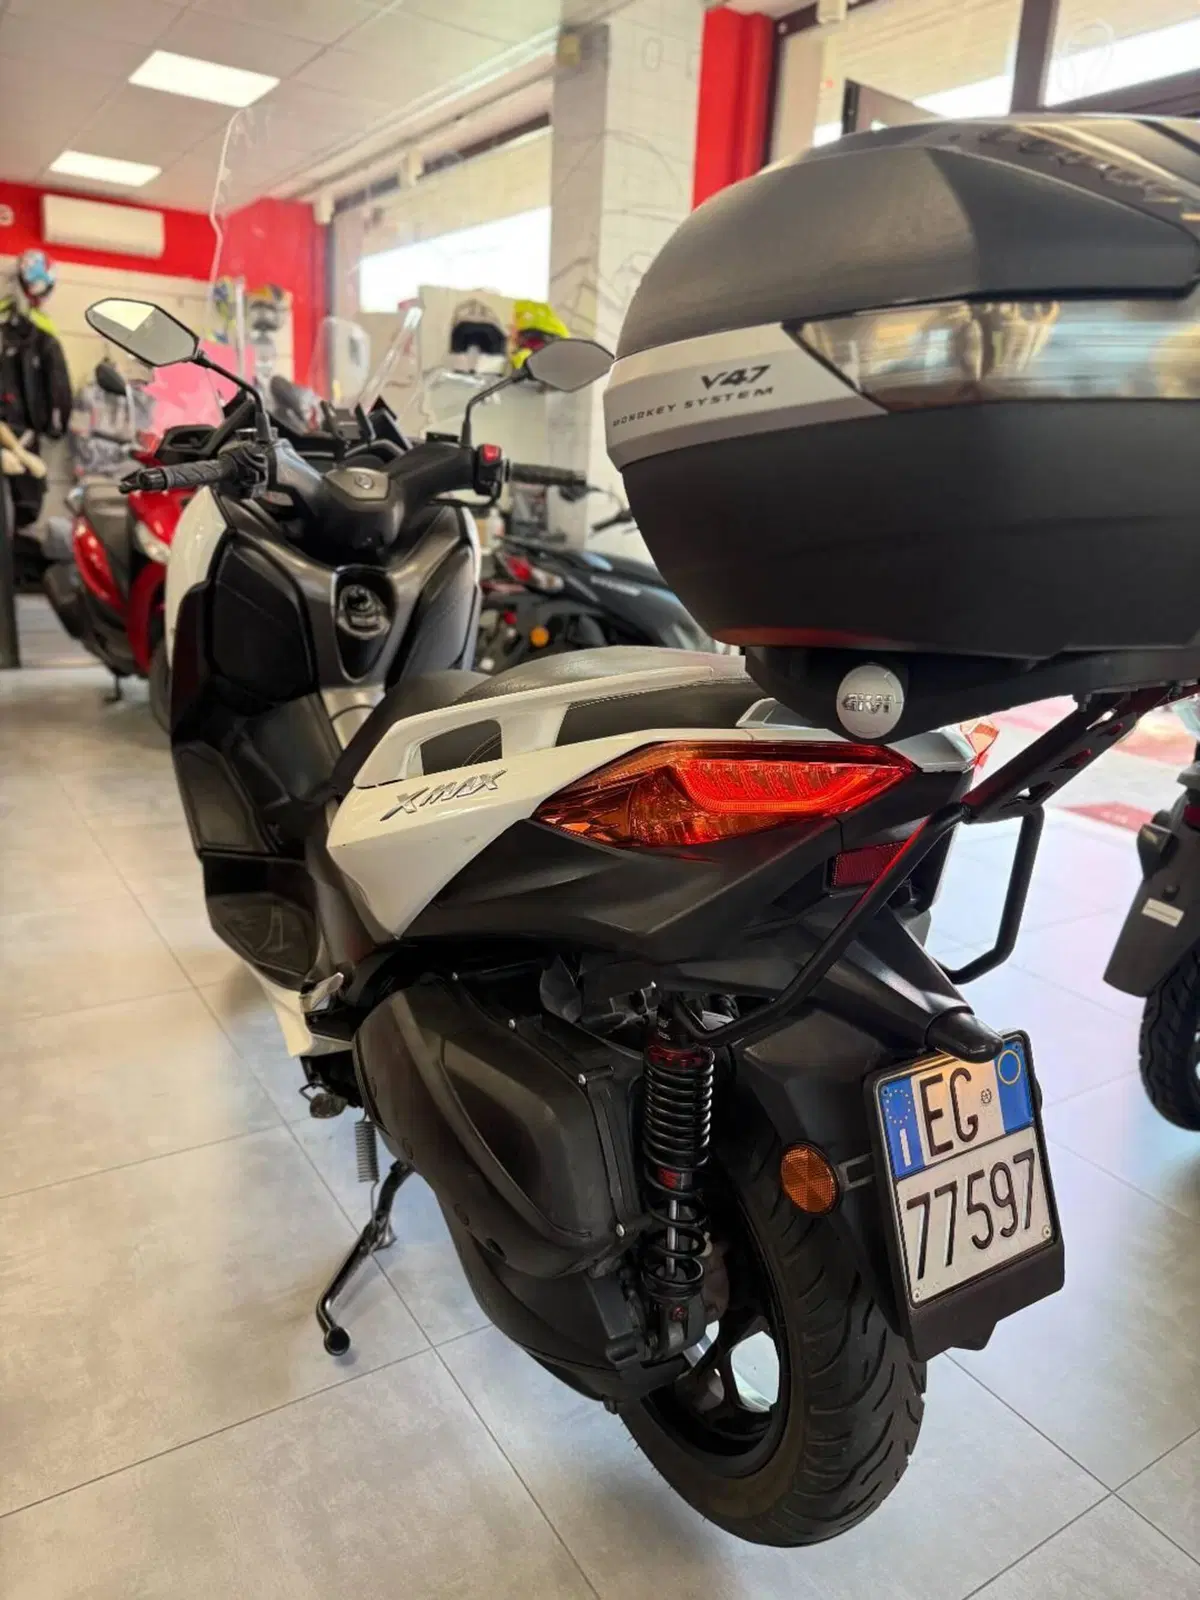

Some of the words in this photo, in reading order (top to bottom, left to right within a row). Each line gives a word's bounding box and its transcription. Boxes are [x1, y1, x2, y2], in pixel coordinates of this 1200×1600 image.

[684, 386, 774, 409] SYSTEM
[701, 364, 771, 390] V47
[919, 1067, 979, 1157] EG
[906, 1148, 1035, 1280] 77597
